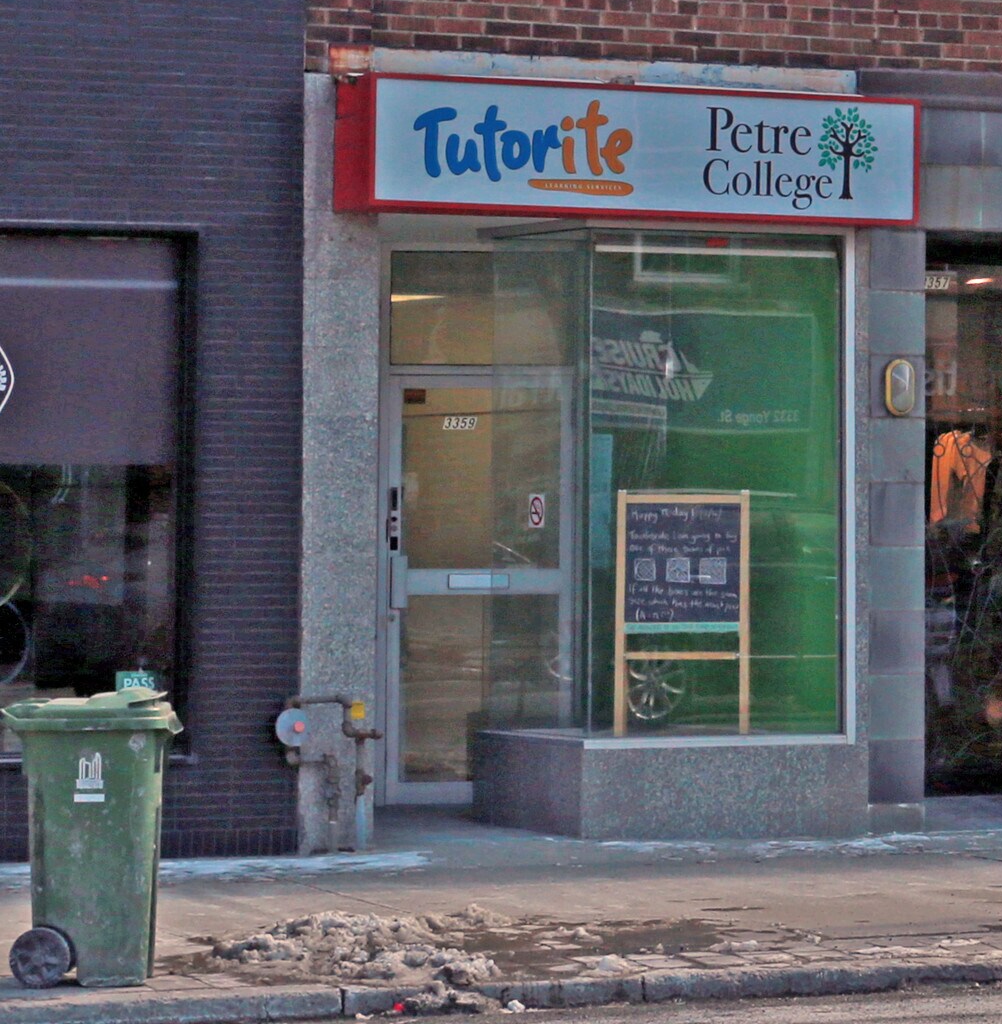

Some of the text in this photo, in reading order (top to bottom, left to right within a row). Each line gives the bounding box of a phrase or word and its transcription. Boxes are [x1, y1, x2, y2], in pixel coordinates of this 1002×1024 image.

[413, 99, 633, 182] Tutorite
[705, 106, 812, 155] Petre
[703, 158, 833, 210] College
[925, 276, 949, 288] 357
[444, 417, 476, 429] 3359
[124, 677, 155, 689] PASS
